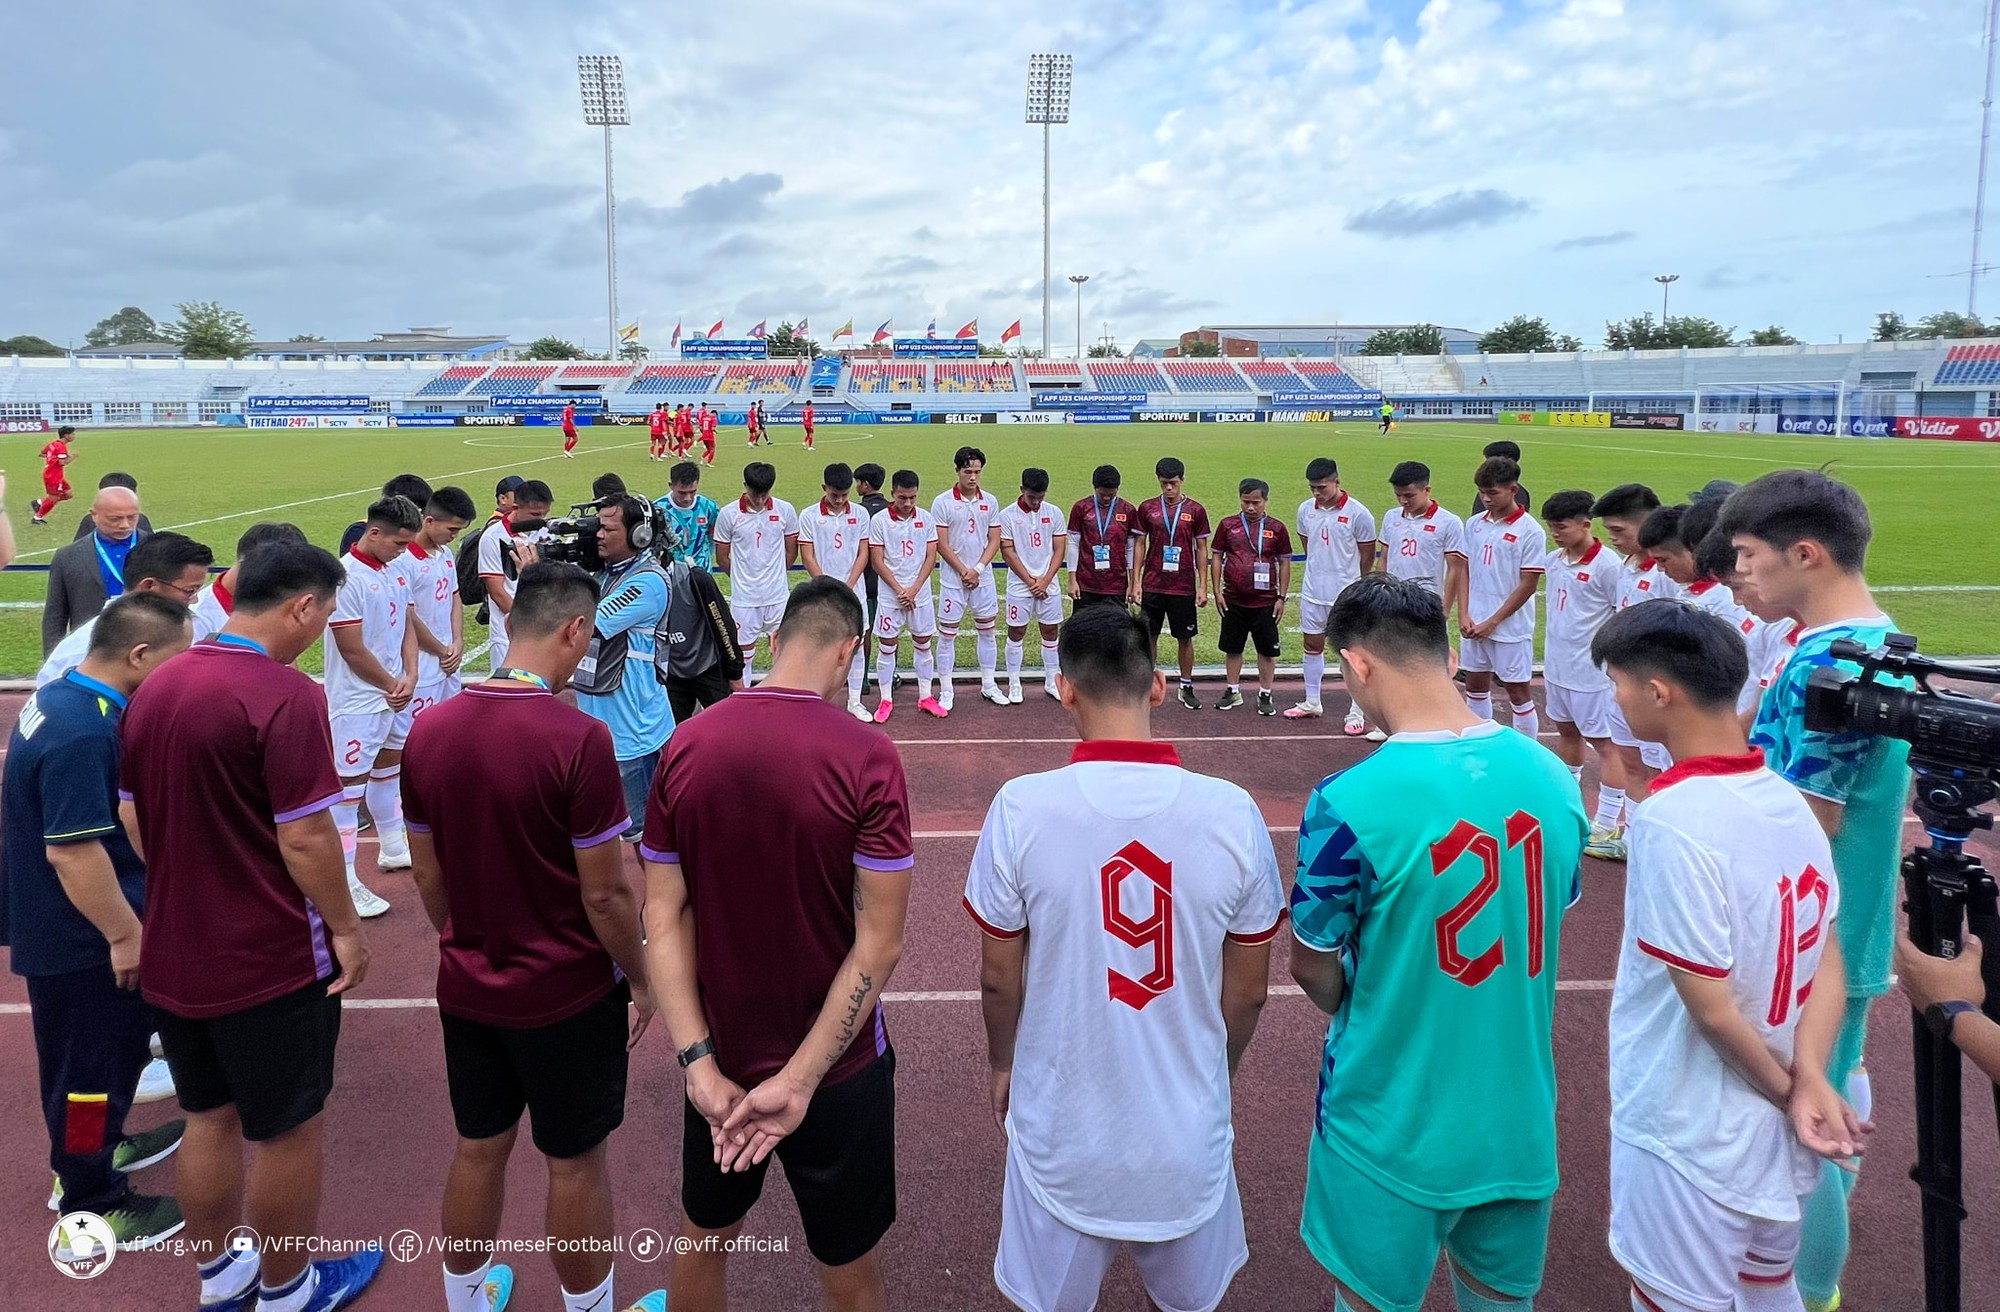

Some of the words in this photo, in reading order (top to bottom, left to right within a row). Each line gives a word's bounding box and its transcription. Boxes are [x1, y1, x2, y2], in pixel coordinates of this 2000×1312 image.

[464, 416, 515, 424] SPORTFIVE
[945, 414, 982, 424] SELECT
[1024, 415, 1050, 423] AIMS
[1139, 413, 1190, 421] SPORTFIVE
[1271, 411, 1330, 421] MAKANBOLA
[1793, 420, 1812, 431] ptt
[1864, 422, 1888, 433] ptt
[1904, 419, 1959, 435] Vidio
[968, 518, 975, 534] 3
[756, 531, 762, 548] 7
[1029, 532, 1041, 547] 18
[1321, 528, 1329, 545] 4
[1401, 538, 1417, 557] 20
[1483, 544, 1492, 565] 11
[944, 599, 952, 613] 3
[1557, 588, 1568, 611] 17
[345, 739, 361, 765] 2
[1429, 808, 1544, 988] 21
[1100, 839, 1175, 1012] 9
